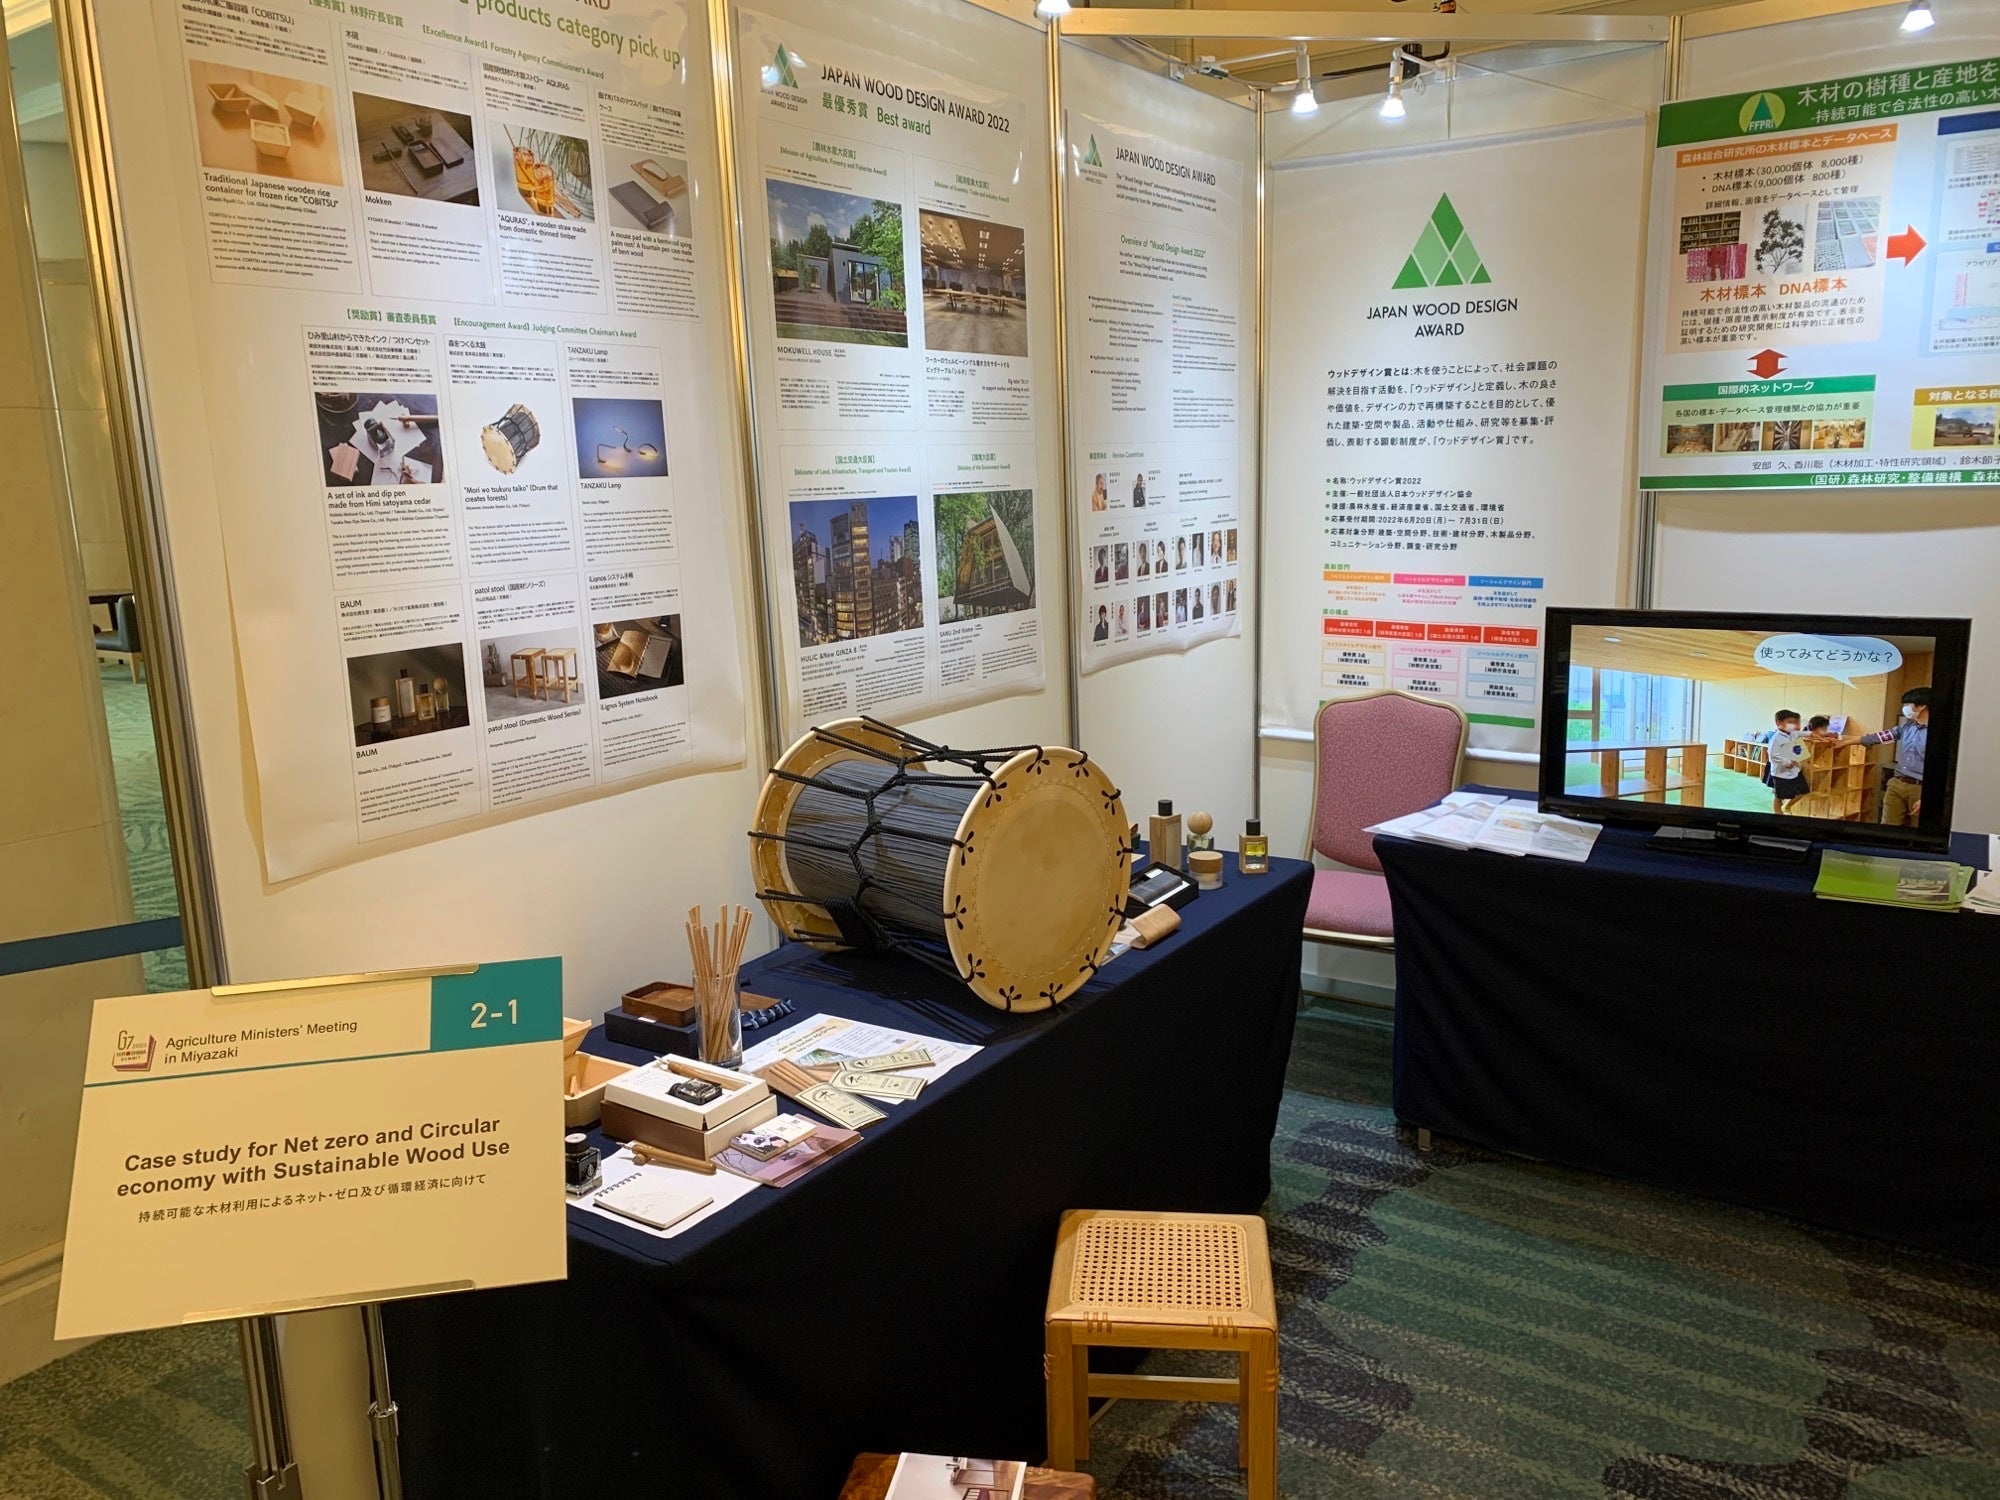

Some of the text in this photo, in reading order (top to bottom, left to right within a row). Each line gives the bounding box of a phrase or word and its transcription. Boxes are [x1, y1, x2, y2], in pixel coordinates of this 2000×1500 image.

[476, 0, 551, 27] products
[557, 17, 623, 54] category
[629, 35, 658, 58] pick
[663, 48, 680, 70] up
[1797, 61, 1999, 106] 木材の樹種と産地を
[822, 65, 1009, 133] JAPAN WOOD DESIGN AWARD 2022
[823, 92, 930, 135] 最優秀賞 Best award
[1749, 119, 1775, 131] FFPRI
[1116, 148, 1215, 185] JAPAN WOOD DESIGN AWARD
[204, 173, 330, 198] Traditional Japanese wooden rice
[205, 184, 244, 196] container
[246, 188, 257, 197] for
[259, 190, 281, 201] frozen
[284, 193, 298, 203] rice
[366, 195, 392, 206] Mokken
[1700, 277, 1847, 302] 木材標本 DNA標本
[1367, 298, 1517, 319] JAPAN WOOD DESIGN
[1415, 323, 1464, 337] AWARD
[777, 346, 833, 357] MOKUWELL HOUSE
[1718, 380, 1815, 396] 国際的ネットワーク
[328, 489, 406, 501] A set of ink and dip pen
[580, 481, 622, 491] TANZAKU Lamp
[340, 600, 361, 608] BAUM
[1760, 646, 1893, 664] 使ってみてどうかな？
[488, 708, 582, 735] patol stool (Domestic Wood Series)
[356, 749, 377, 758] BAUM
[471, 999, 516, 1028] 2-1
[165, 1021, 357, 1050] Agriculture Ministers' Meeting
[164, 1046, 238, 1064] in Miyazaki
[125, 1118, 501, 1171] Case study for Net zero and Circular
[118, 1141, 509, 1196] economy with Sustainable Wood Use
[139, 1174, 485, 1223] 持続可能な木材利用によるネット・ゼロ及び循環経済に向けて
